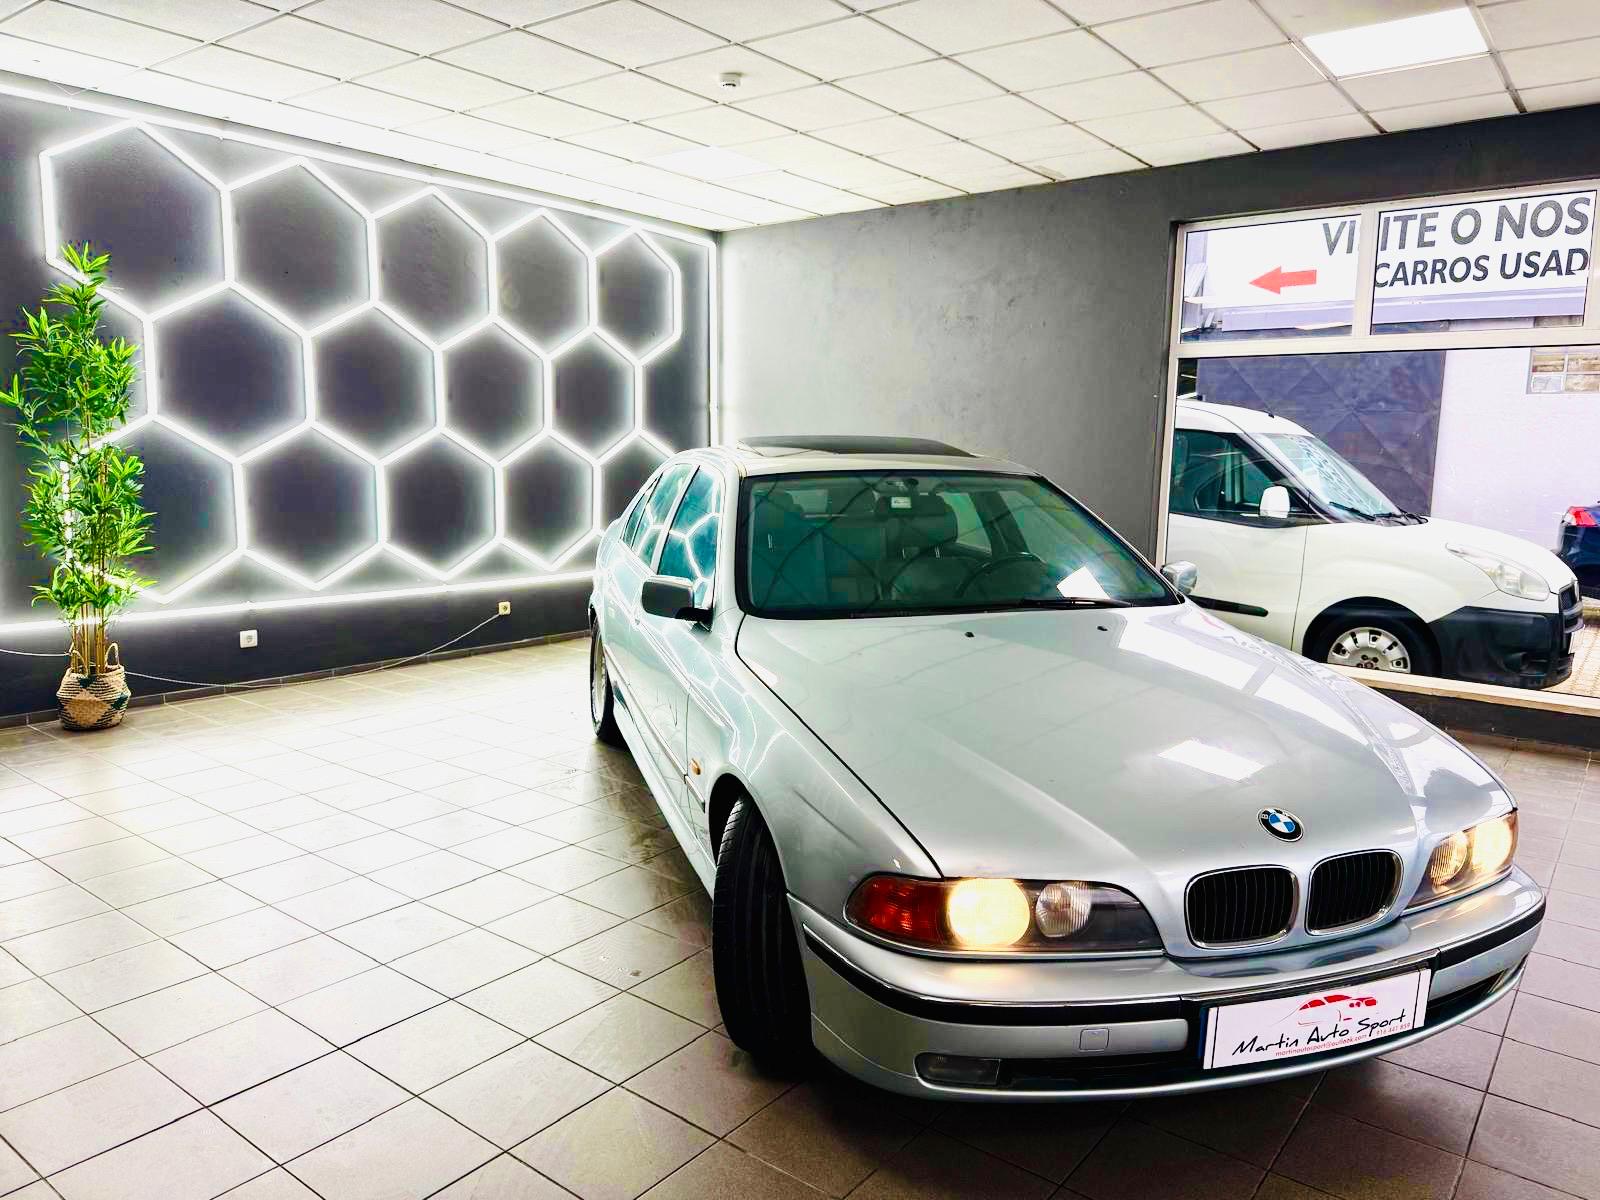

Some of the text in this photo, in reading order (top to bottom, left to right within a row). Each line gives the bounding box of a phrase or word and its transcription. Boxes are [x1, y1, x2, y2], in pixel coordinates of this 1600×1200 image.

[1323, 212, 1439, 256] VIITE
[1451, 208, 1482, 245] O
[1375, 255, 1490, 288] CARROS
[1232, 1009, 1406, 1056] Martin Auto Sport
